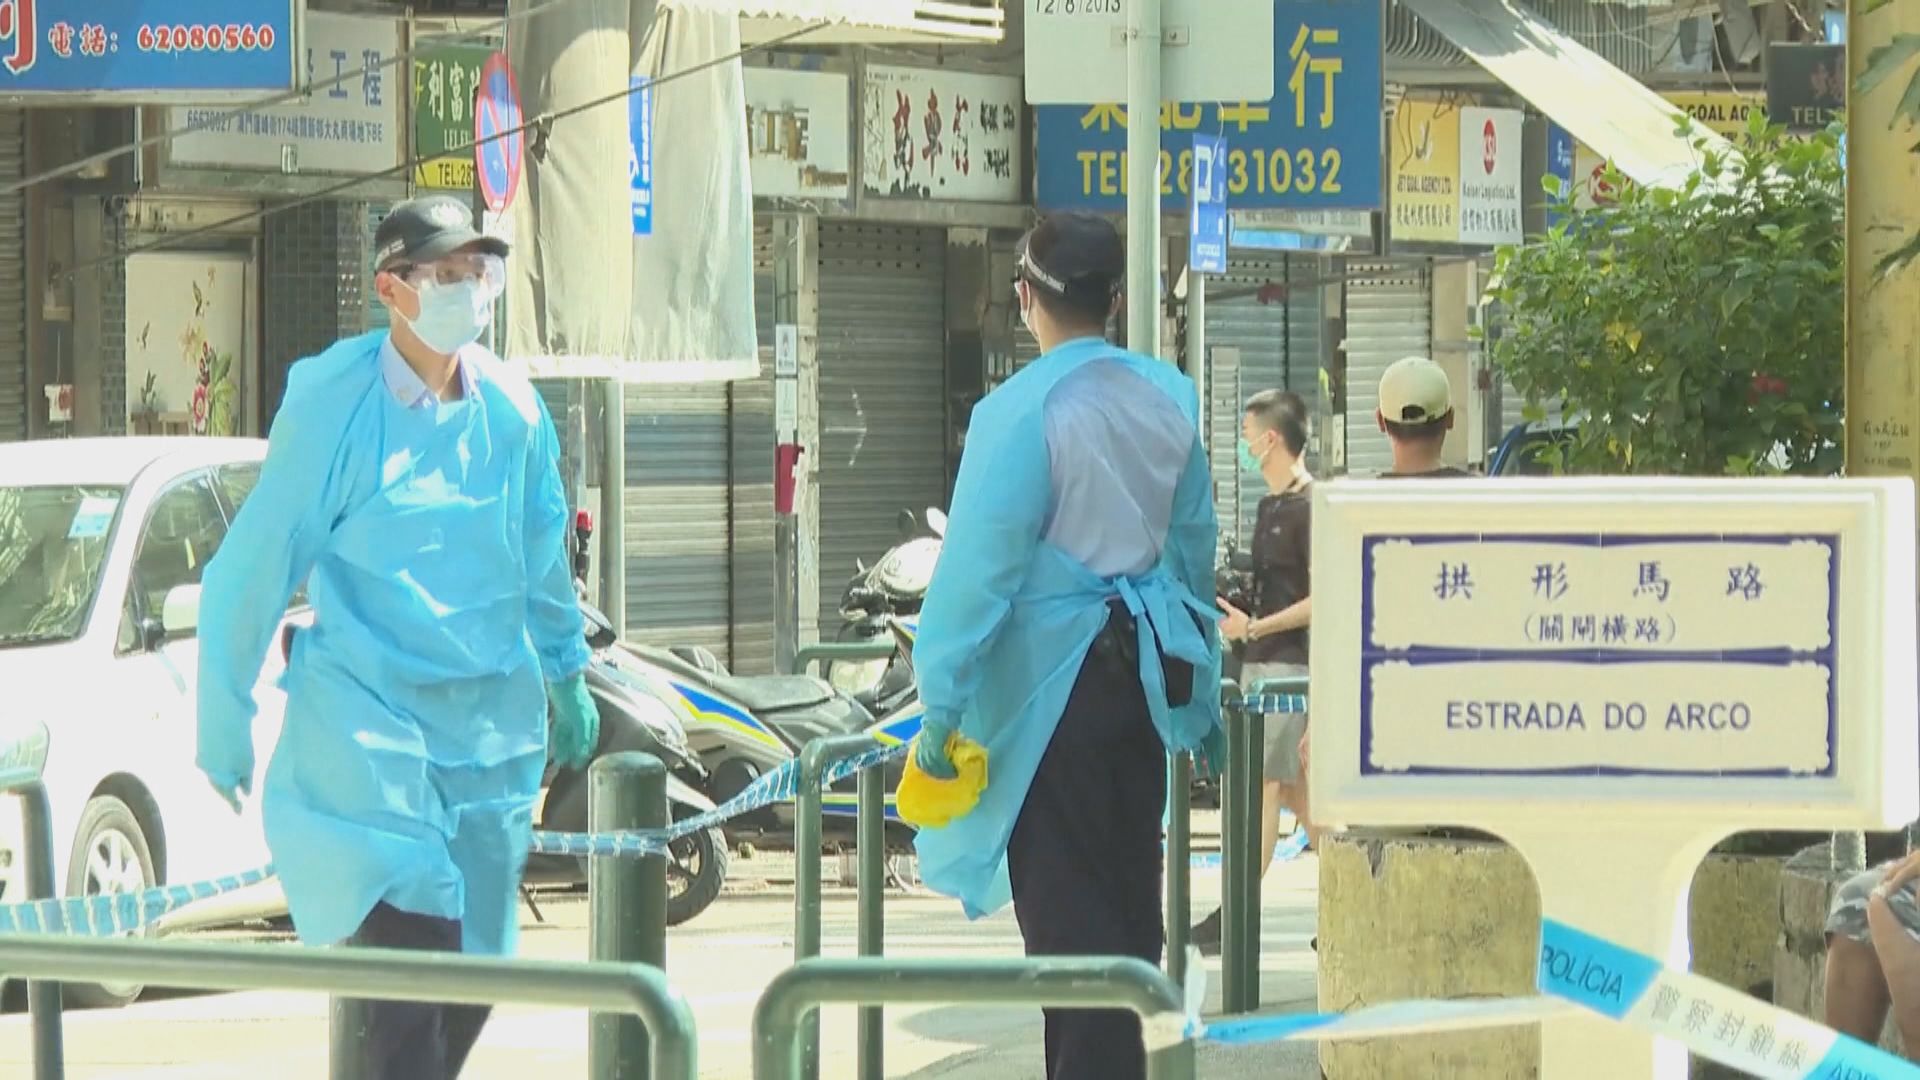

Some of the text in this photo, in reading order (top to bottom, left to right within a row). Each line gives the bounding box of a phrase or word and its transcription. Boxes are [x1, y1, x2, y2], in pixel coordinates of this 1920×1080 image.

[137, 24, 274, 53] 62080560
[1160, 148, 1342, 194] 2831032
[1434, 561, 1766, 601] 拱形馬路
[1447, 702, 1751, 730] ESTRADA DO ARCO
[1542, 945, 1624, 1003] POLÍCIA
[1651, 983, 1808, 1072] 警察封鎖線
